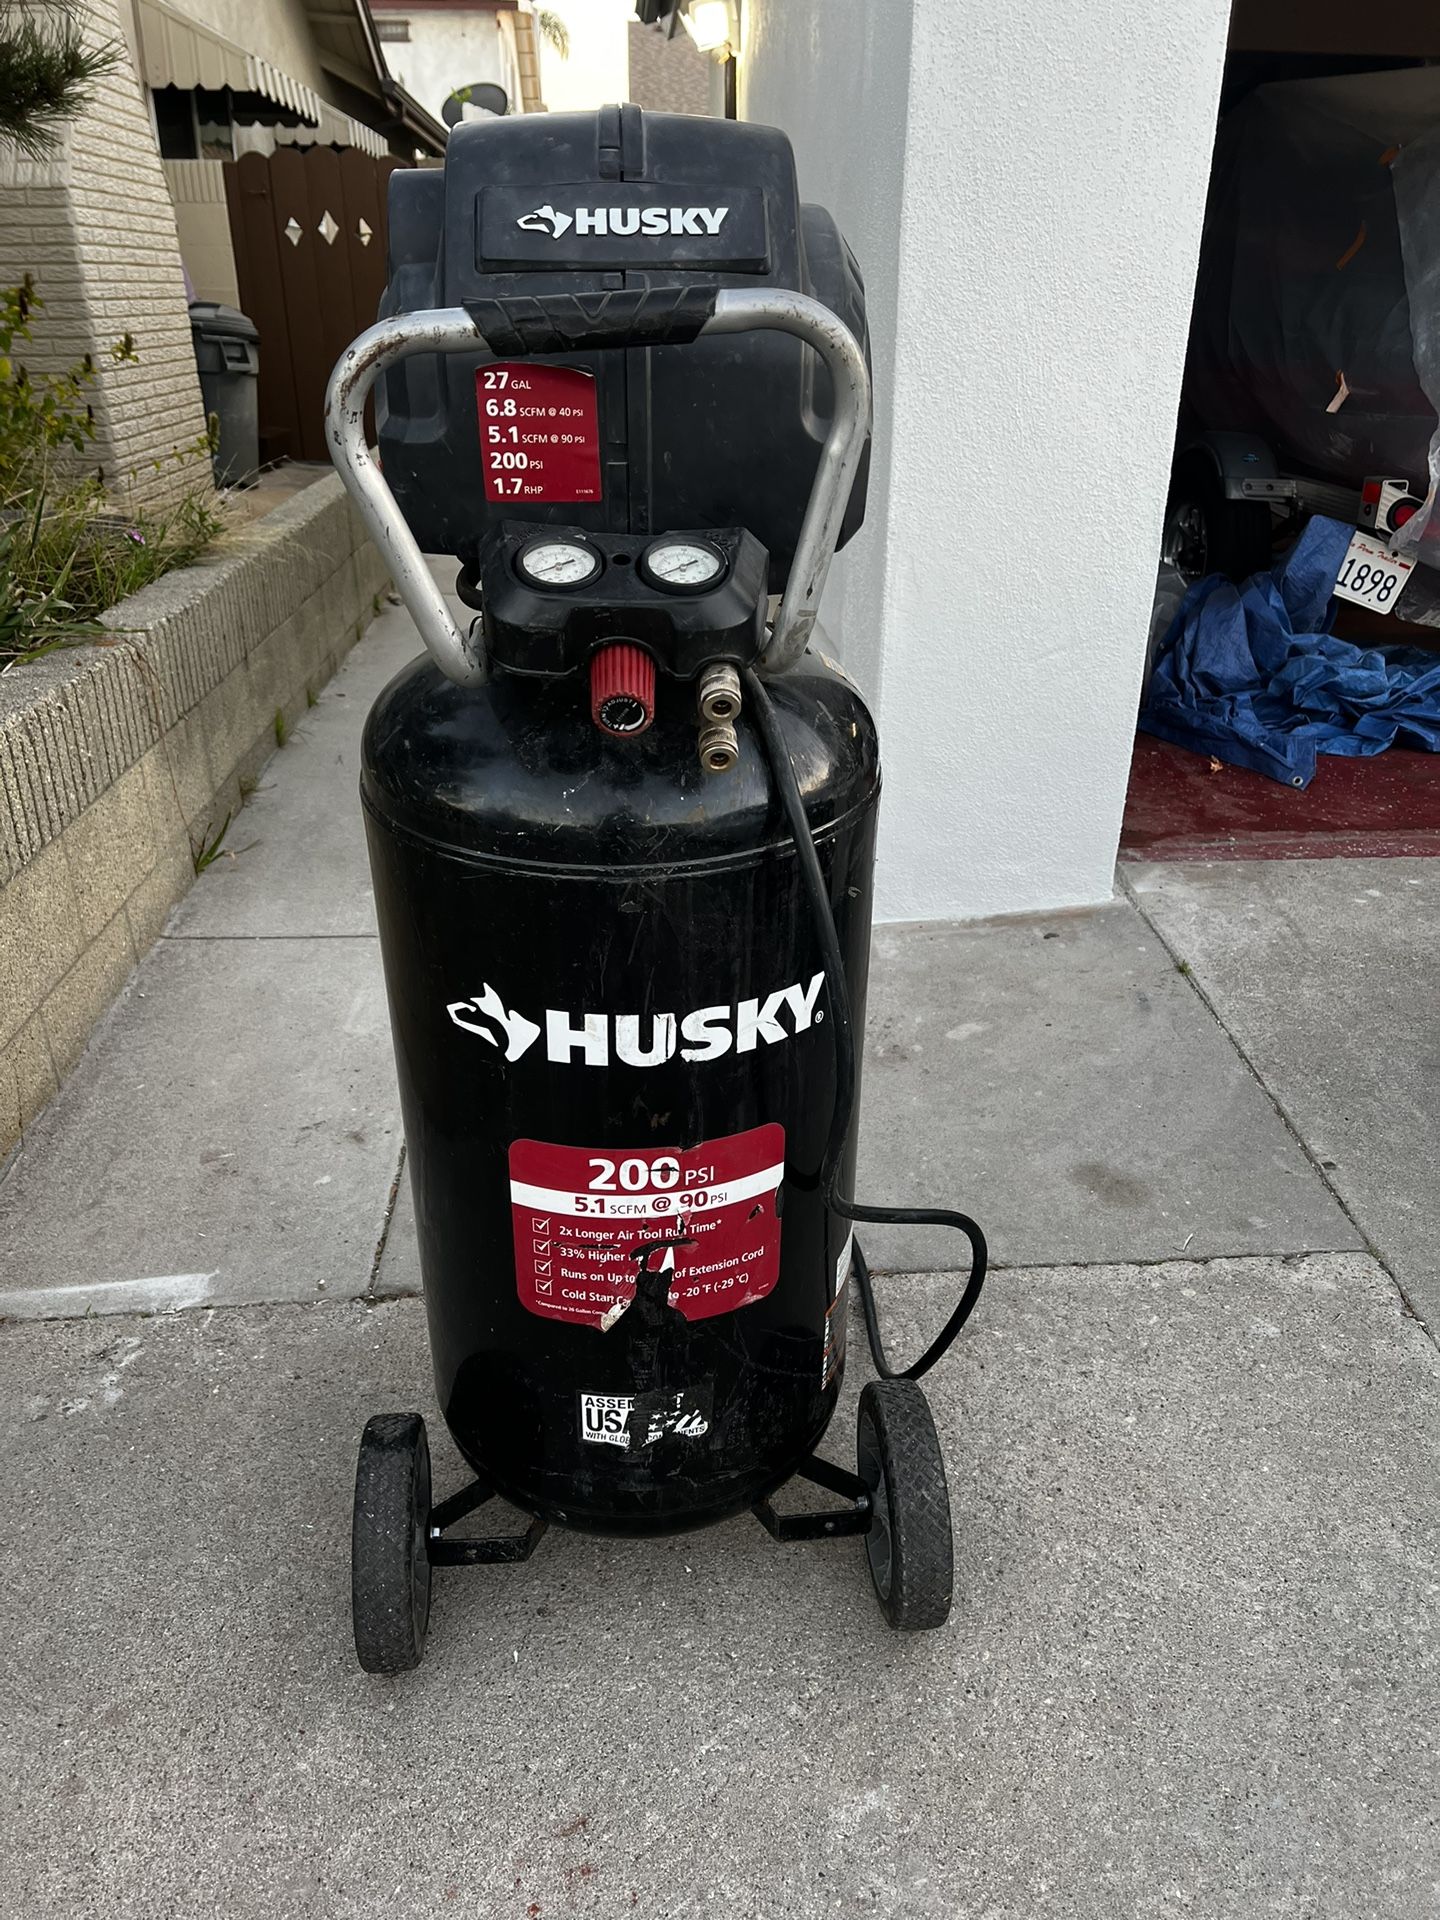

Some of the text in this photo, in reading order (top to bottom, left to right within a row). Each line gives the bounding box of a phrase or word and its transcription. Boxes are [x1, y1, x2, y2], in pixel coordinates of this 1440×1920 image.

[575, 207, 729, 235] HUSKY
[484, 372, 531, 389] 27 GAL
[485, 398, 517, 417] 6.8
[519, 407, 546, 417] SCFM
[548, 407, 557, 417] @
[559, 407, 571, 417] 40
[488, 425, 585, 444] 5.1 SCFM @ 90 PSI
[490, 452, 543, 470] 200 PSI
[493, 478, 544, 495] 1.7 RHP
[1336, 558, 1397, 602] 1898
[546, 971, 826, 1067] HUSKY
[588, 1156, 715, 1191] 200 PSI
[574, 1191, 728, 1215] 5.1 SCFM @ 90 PSI
[559, 1225, 572, 1236] 2x
[575, 1228, 614, 1241] Longer
[617, 1230, 635, 1240] Air
[637, 1229, 662, 1240] Tool
[560, 1246, 625, 1263] 33% Higher
[561, 1246, 764, 1285] Runs on Up to of Extension Cord
[561, 1288, 586, 1301] Cold
[589, 1292, 614, 1305] Start
[682, 1286, 700, 1298] -20
[713, 1279, 734, 1293] (-29
[585, 1431, 607, 1441] WITH
